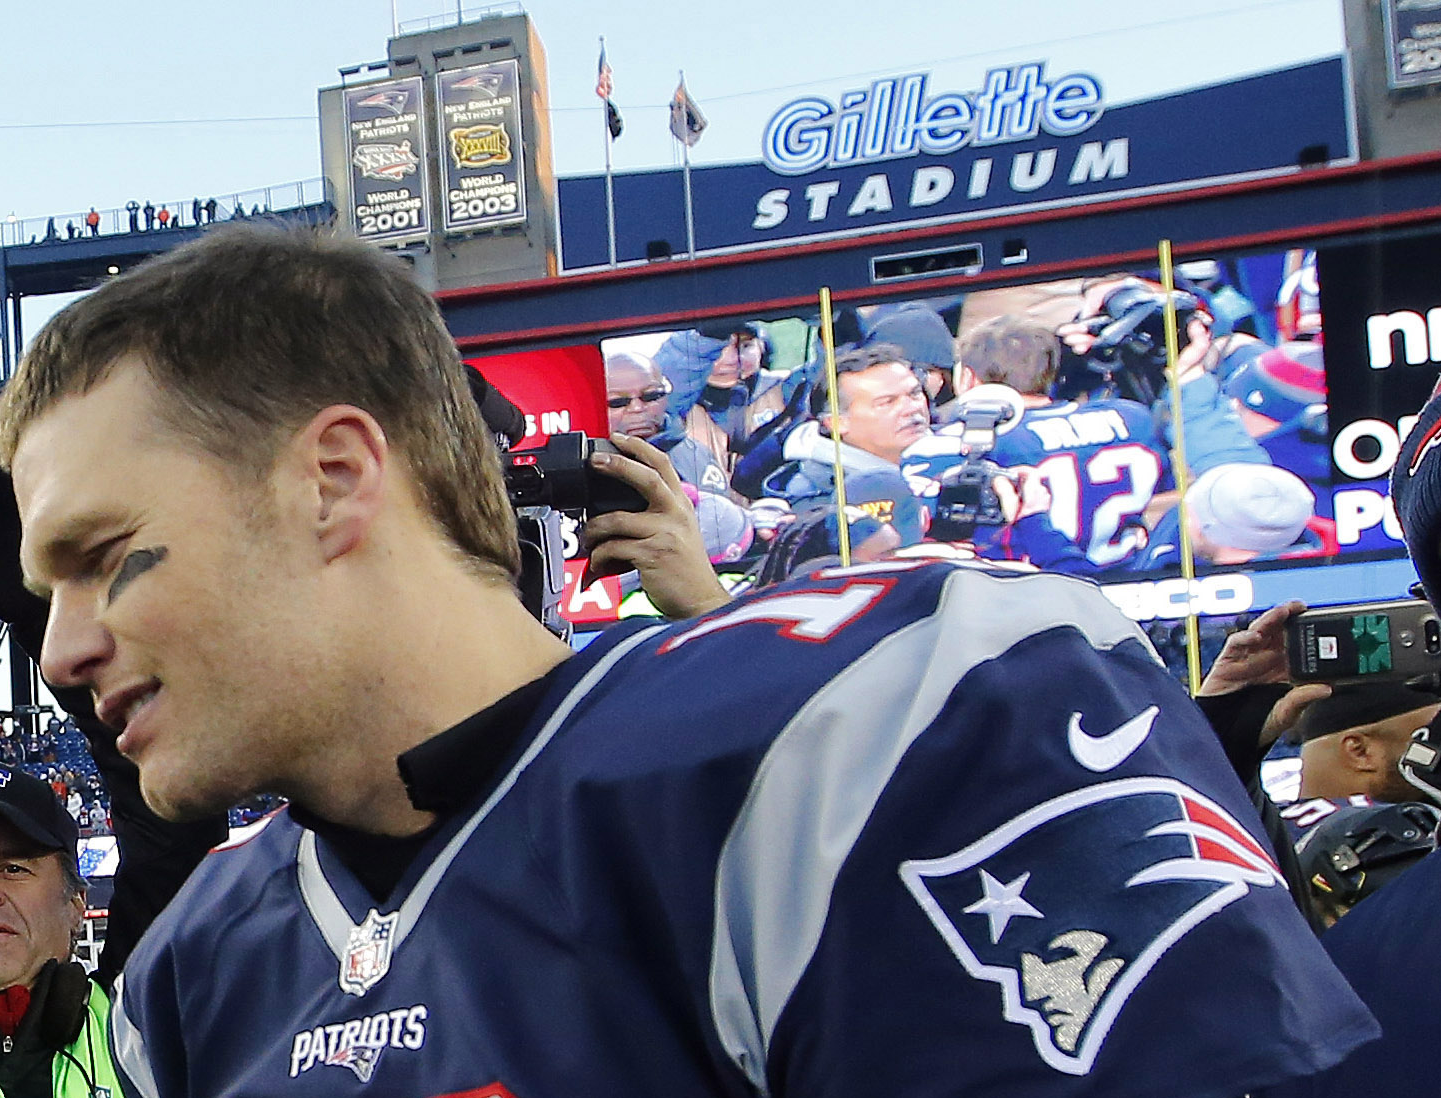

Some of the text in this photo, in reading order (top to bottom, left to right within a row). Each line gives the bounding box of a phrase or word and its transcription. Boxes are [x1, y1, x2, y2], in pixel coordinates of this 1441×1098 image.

[763, 60, 1105, 176] Gillette
[449, 182, 517, 202] CHAMPIONS
[461, 174, 504, 189] WORLD
[752, 137, 1130, 230] STADIUM
[356, 197, 422, 217] CHAMPIONS
[367, 188, 410, 204] WORLD
[451, 194, 517, 220] 2003
[361, 209, 420, 233] 2001
[541, 410, 571, 435] IN
[288, 1004, 428, 1078] PATRIOTS
